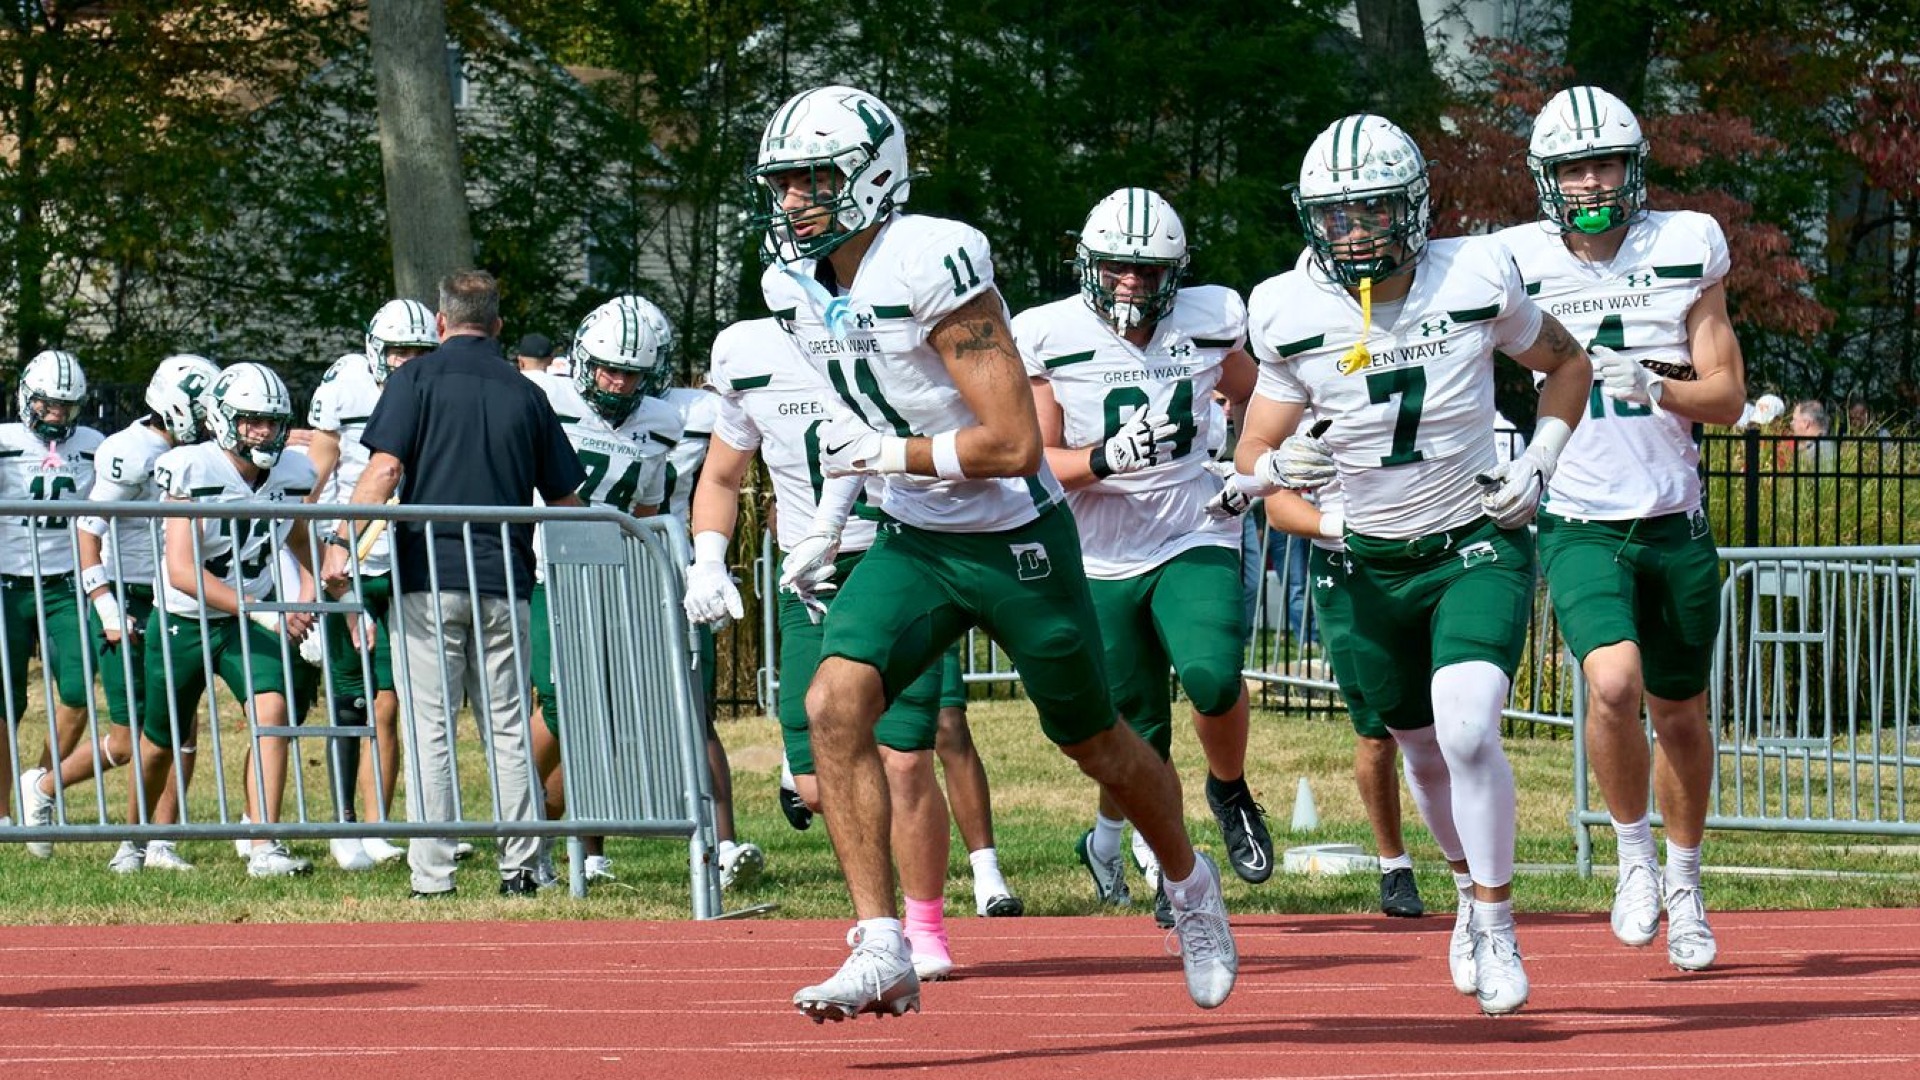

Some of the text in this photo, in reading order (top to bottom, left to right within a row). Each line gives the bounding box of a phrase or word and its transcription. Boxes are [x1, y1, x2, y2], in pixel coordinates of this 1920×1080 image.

[944, 247, 980, 297] 11
[1551, 294, 1652, 316] GREEN WAVE
[808, 339, 881, 355] GREEN WAVE
[1336, 340, 1450, 372] GEN WAVE
[1103, 366, 1191, 384] GREEN WAVE
[778, 401, 824, 415] GREE
[827, 358, 924, 438] 11
[1365, 365, 1427, 467] 7
[581, 437, 643, 460] GREEN WAVE
[112, 457, 124, 479] 5
[574, 450, 642, 513] 74
[1009, 542, 1052, 581] D
